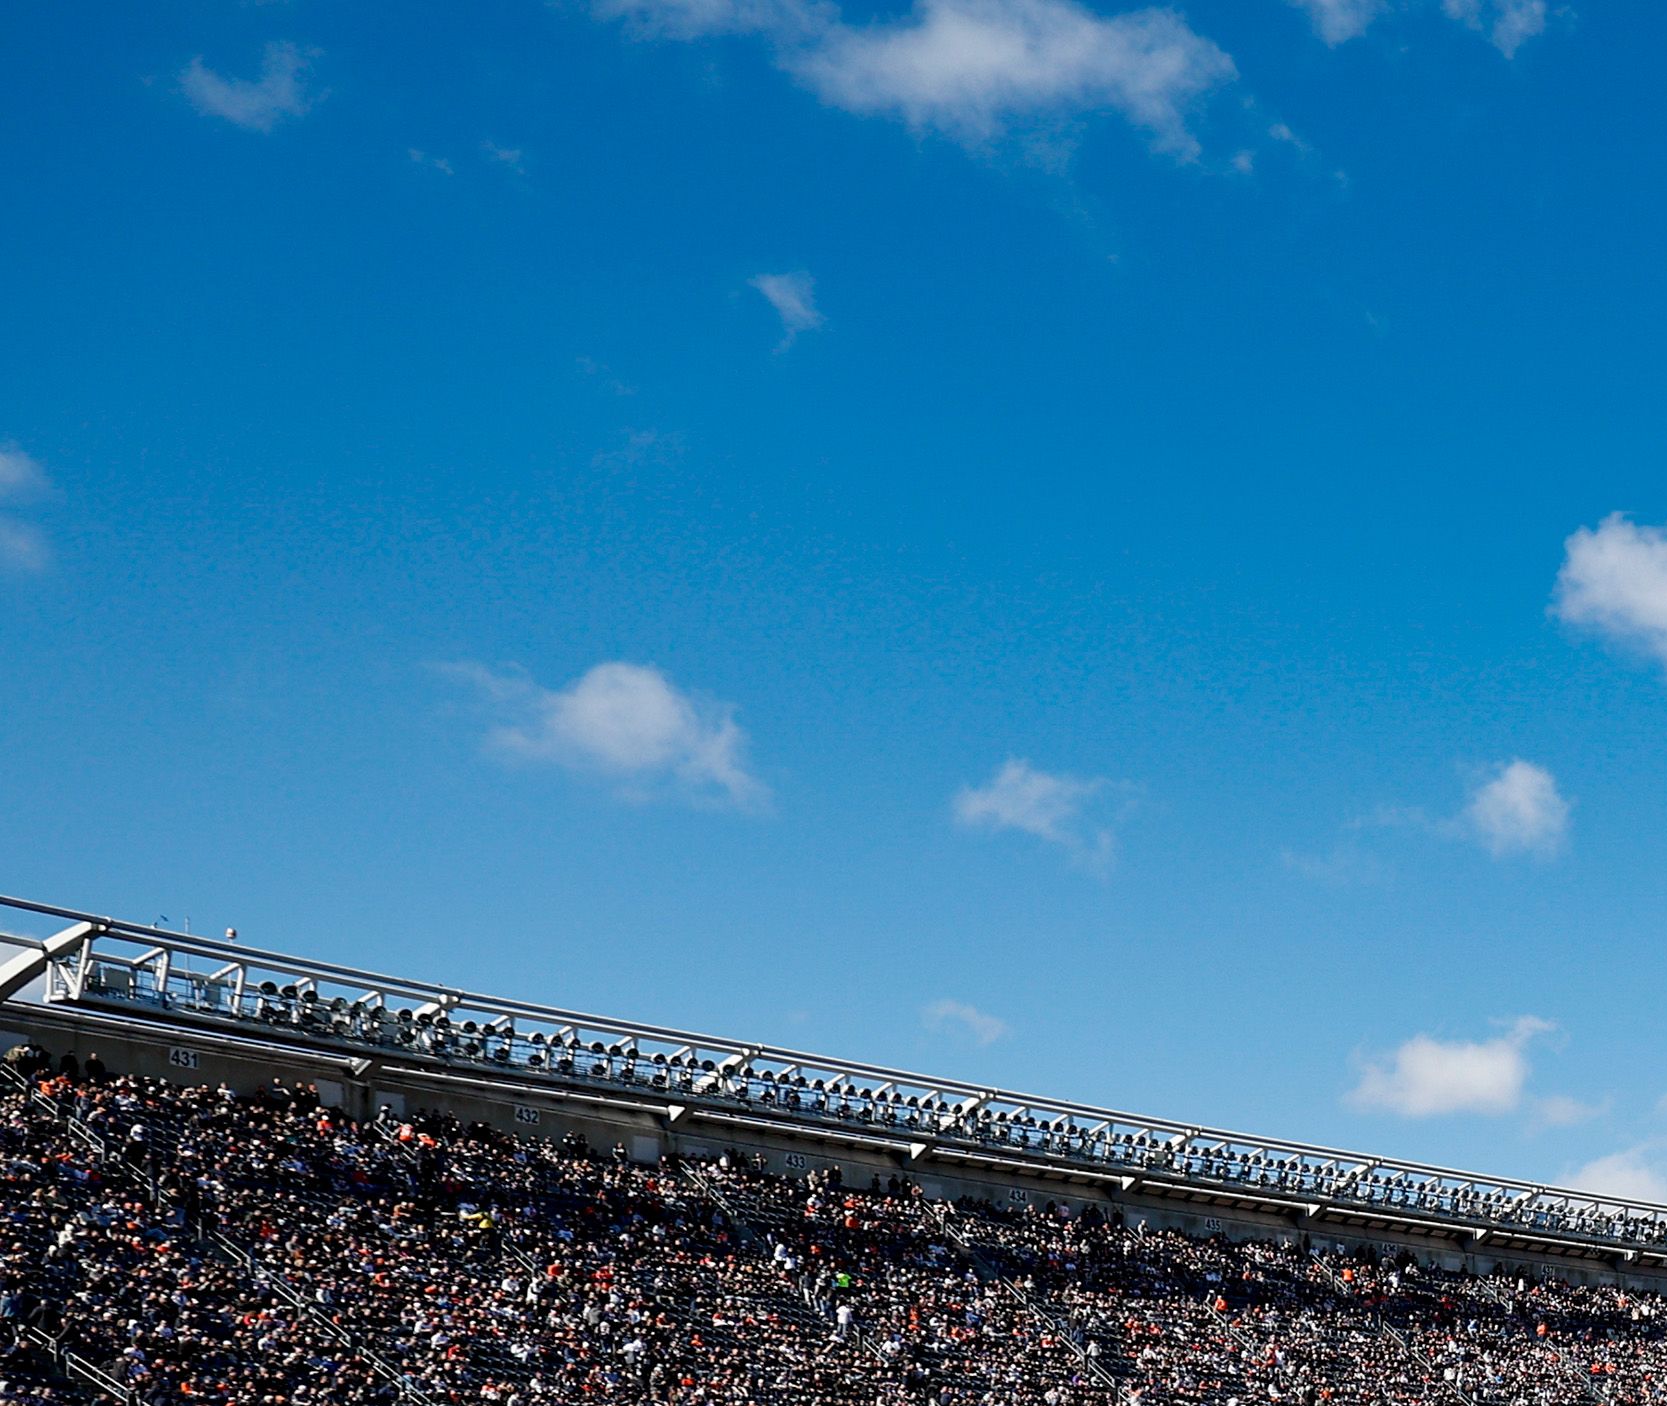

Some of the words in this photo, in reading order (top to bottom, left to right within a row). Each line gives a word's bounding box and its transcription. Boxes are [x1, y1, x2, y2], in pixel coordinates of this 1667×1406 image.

[173, 1050, 199, 1069] 431
[515, 1107, 539, 1125] 432
[785, 1153, 806, 1170] 433
[1009, 1189, 1027, 1204] 434
[1205, 1218, 1221, 1232] 435
